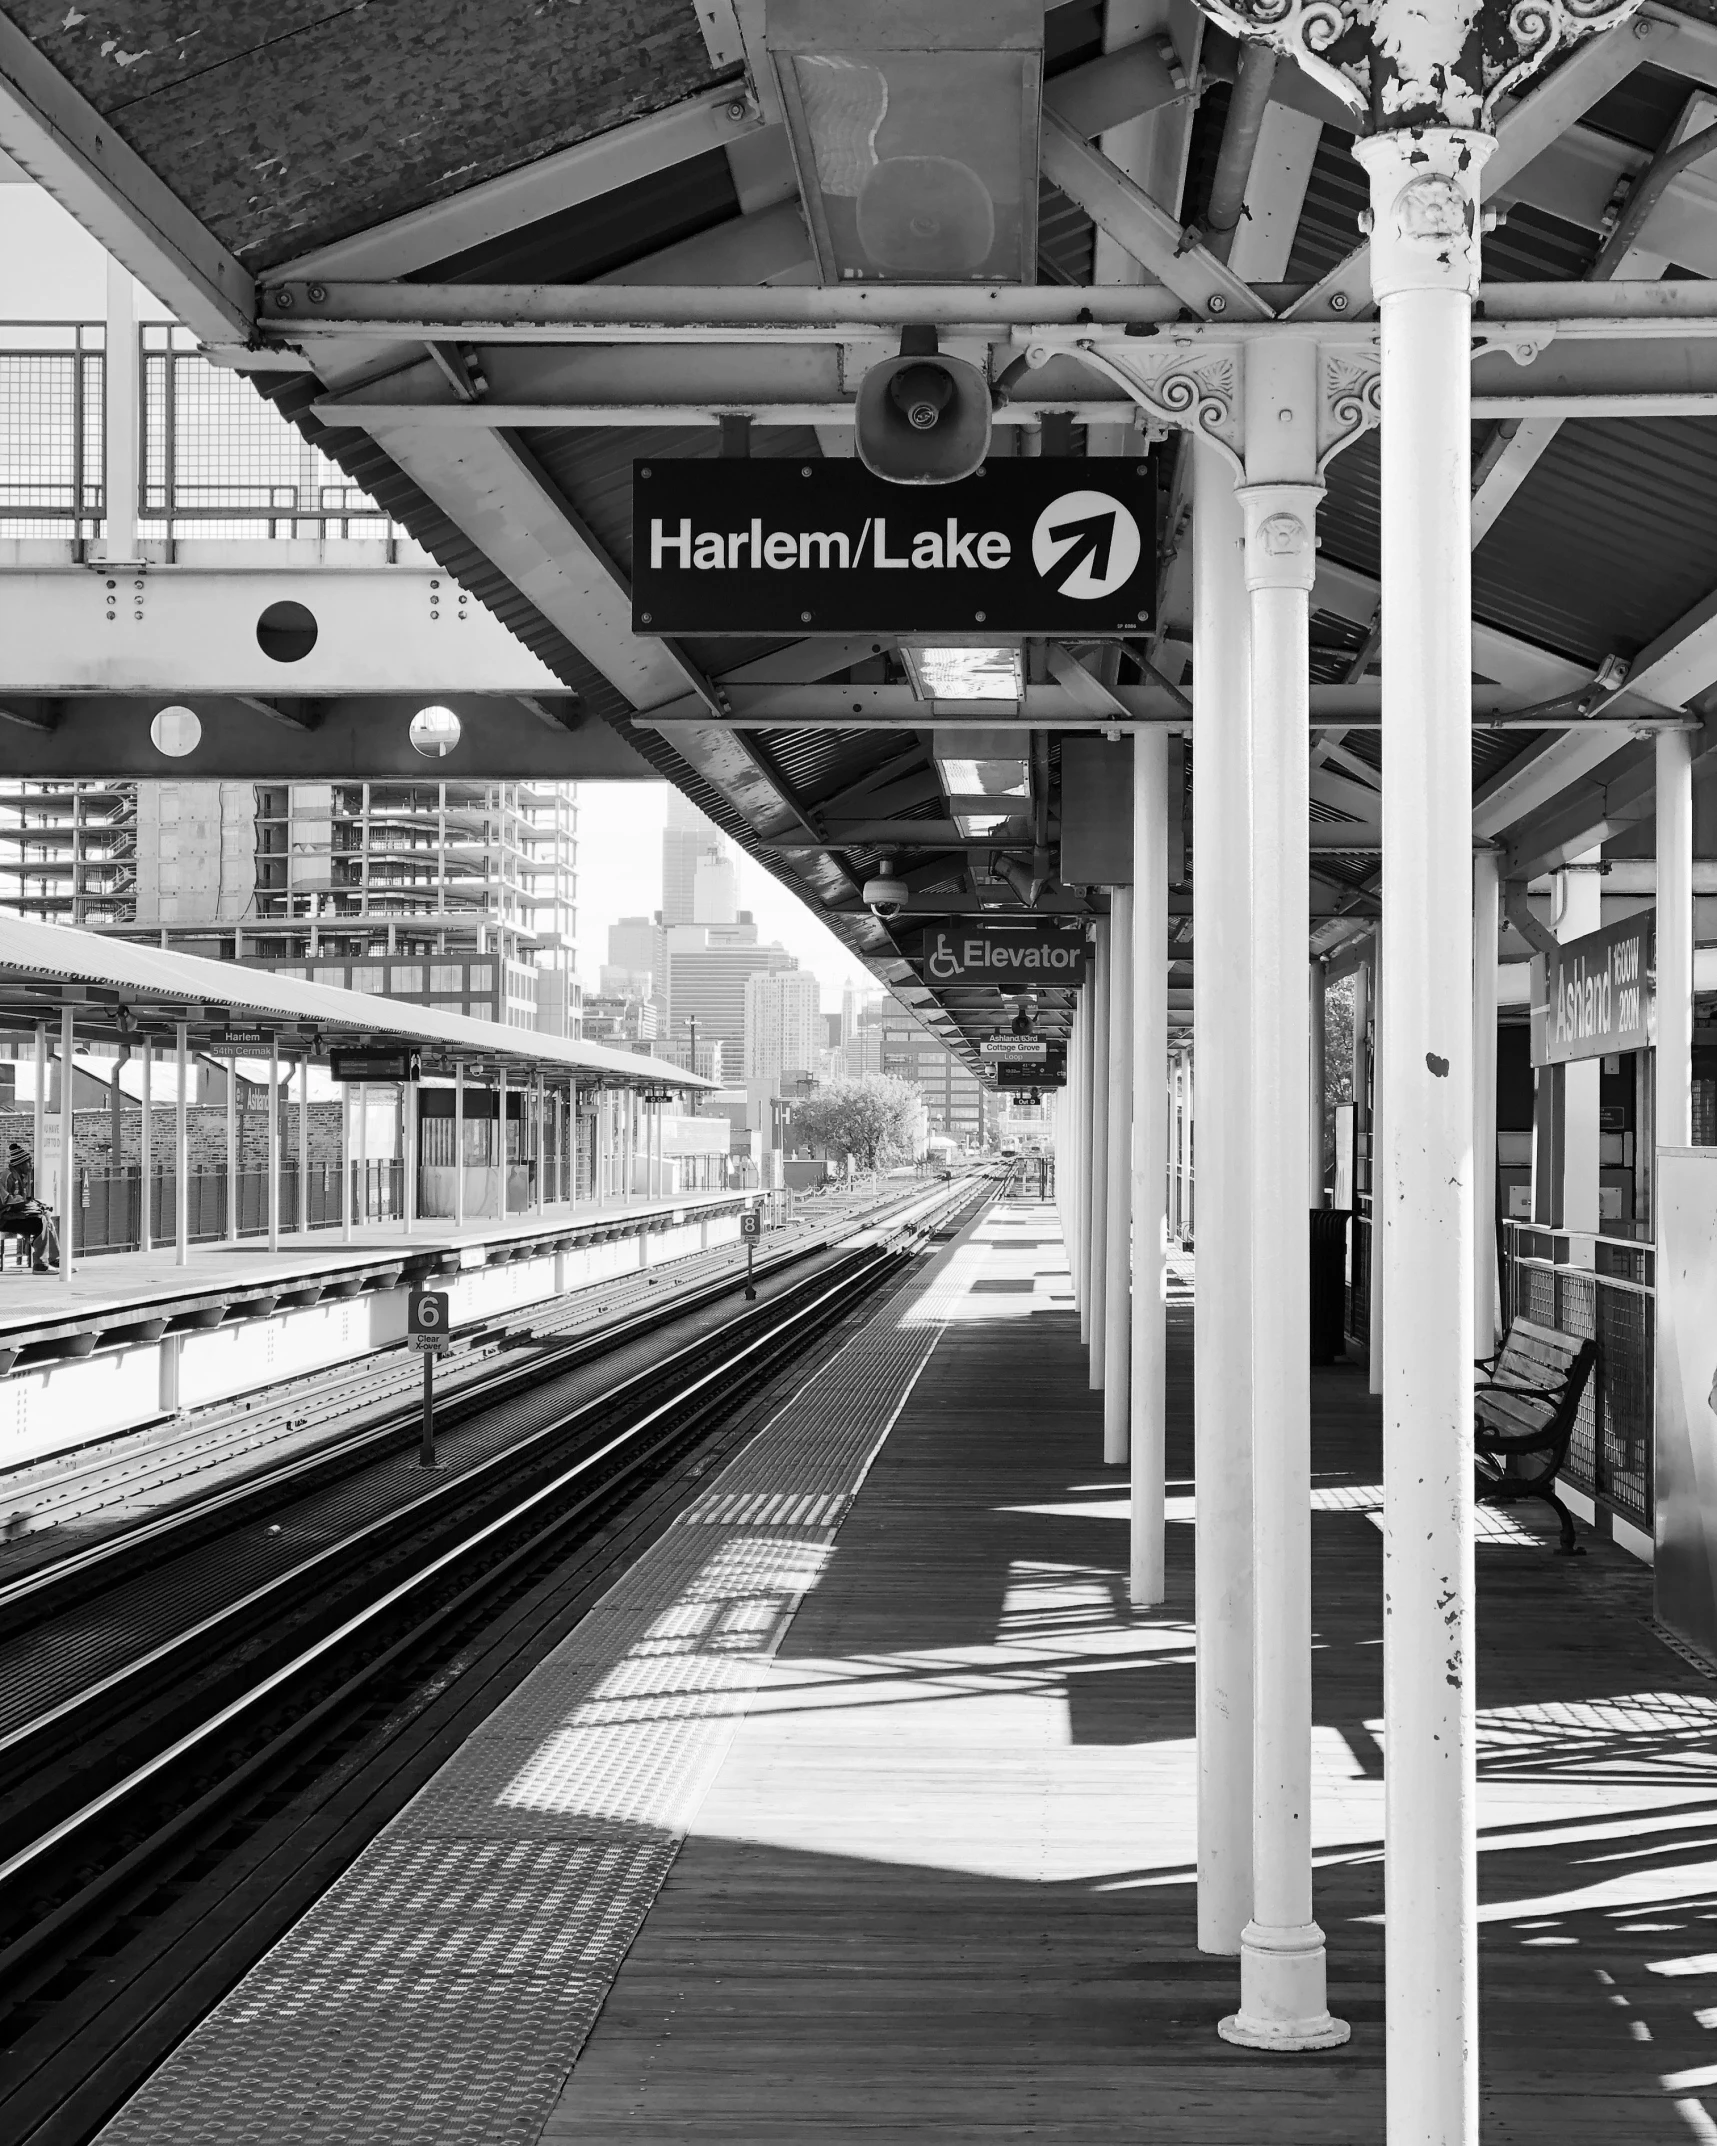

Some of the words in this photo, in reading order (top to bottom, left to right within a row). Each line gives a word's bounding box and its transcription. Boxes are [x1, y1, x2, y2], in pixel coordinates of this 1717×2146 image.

[650, 517, 1011, 570] Harlem/Lake
[964, 940, 1081, 968] Elevator
[1613, 936, 1639, 985] 1600W
[1556, 946, 1611, 1043] Ashland
[1619, 986, 1639, 1032] 200N
[225, 1032, 260, 1042] Harlem
[986, 1044, 1016, 1052] Cottage
[213, 1046, 233, 1055] 54th
[235, 1046, 271, 1055] Cermak
[1004, 1053, 1023, 1061] Loop
[744, 1217, 756, 1233] 8
[418, 1295, 440, 1327] 6
[417, 1334, 440, 1342] Clear
